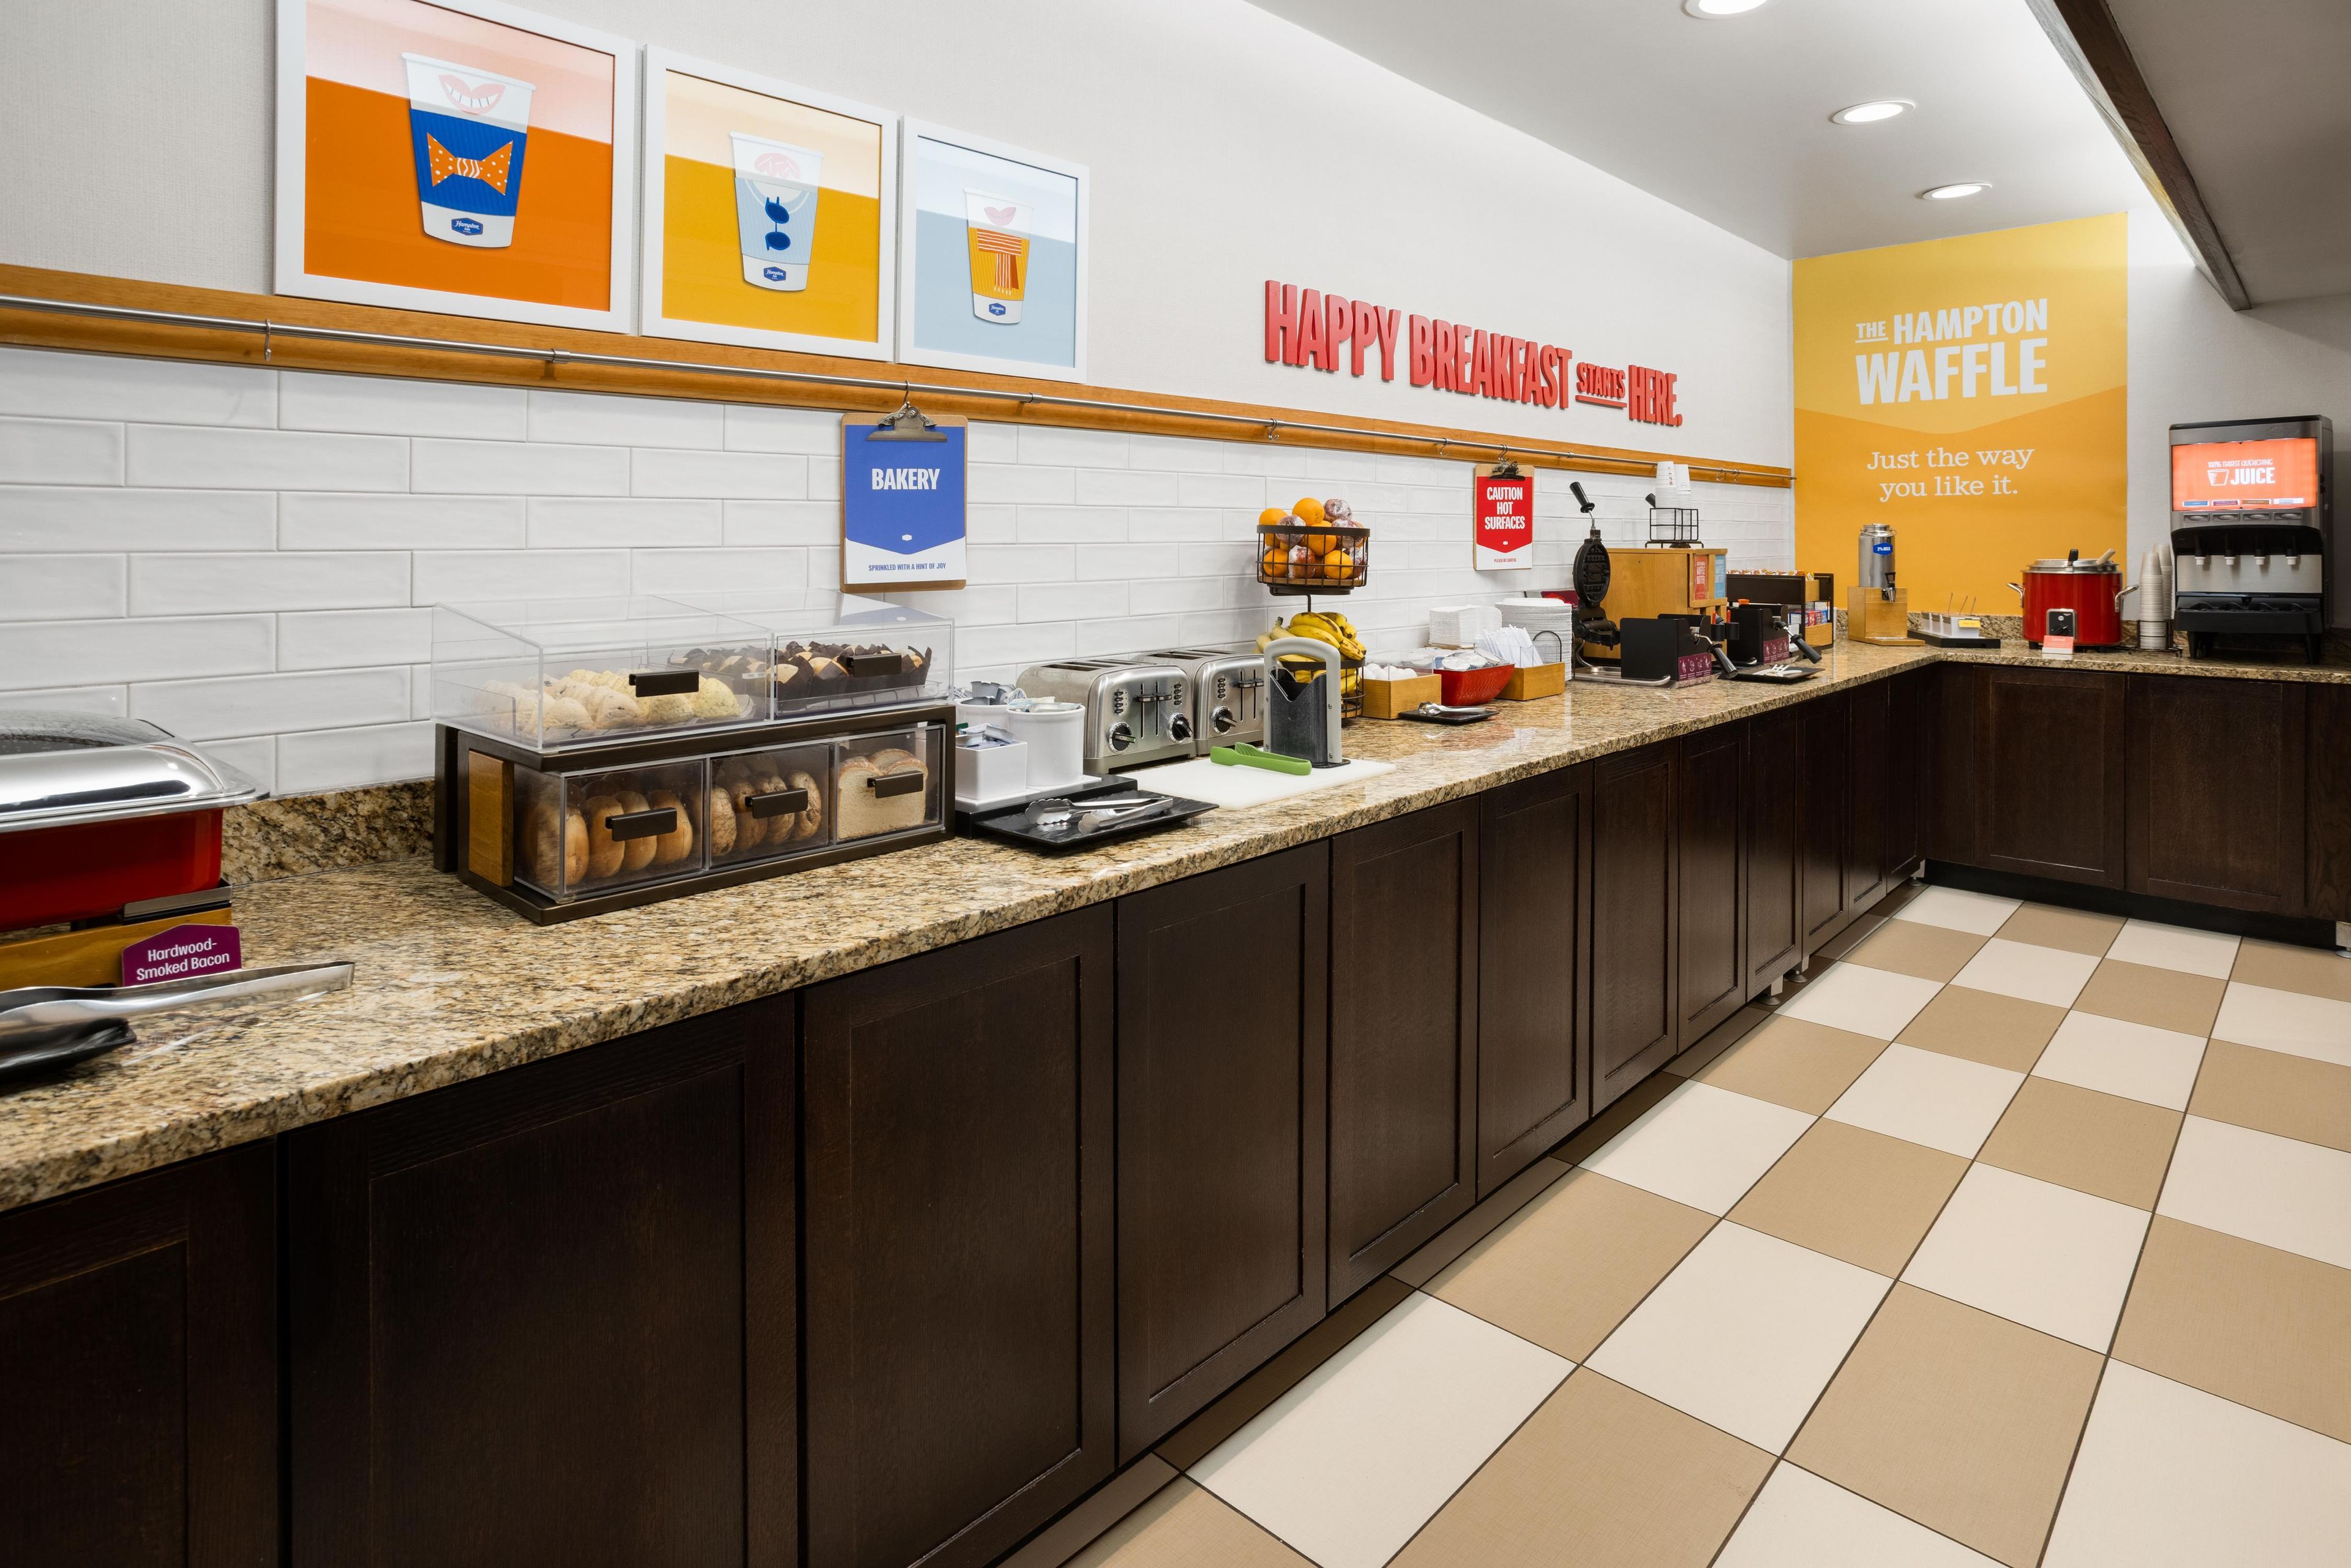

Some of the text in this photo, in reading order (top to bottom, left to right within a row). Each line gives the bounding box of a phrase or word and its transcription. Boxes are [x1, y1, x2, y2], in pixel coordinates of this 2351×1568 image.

[454, 220, 481, 230] Hampton
[1856, 298, 2047, 345] THE HAMPTON
[1265, 280, 1682, 426] HAPPY BREAKFAST STARTS HERE.
[1856, 337, 2047, 405] WAFFLE
[1867, 448, 2035, 470] Just the way
[872, 468, 940, 490] BAKERY
[2230, 467, 2276, 485] JUICE
[1487, 487, 1523, 500] CAUTION
[1880, 475, 2018, 503] you like it.
[1497, 501, 1513, 515] HOT
[1484, 516, 1526, 530] SURFACES
[147, 937, 217, 962] Hardwood-
[137, 953, 230, 981] Smoked Bacon
